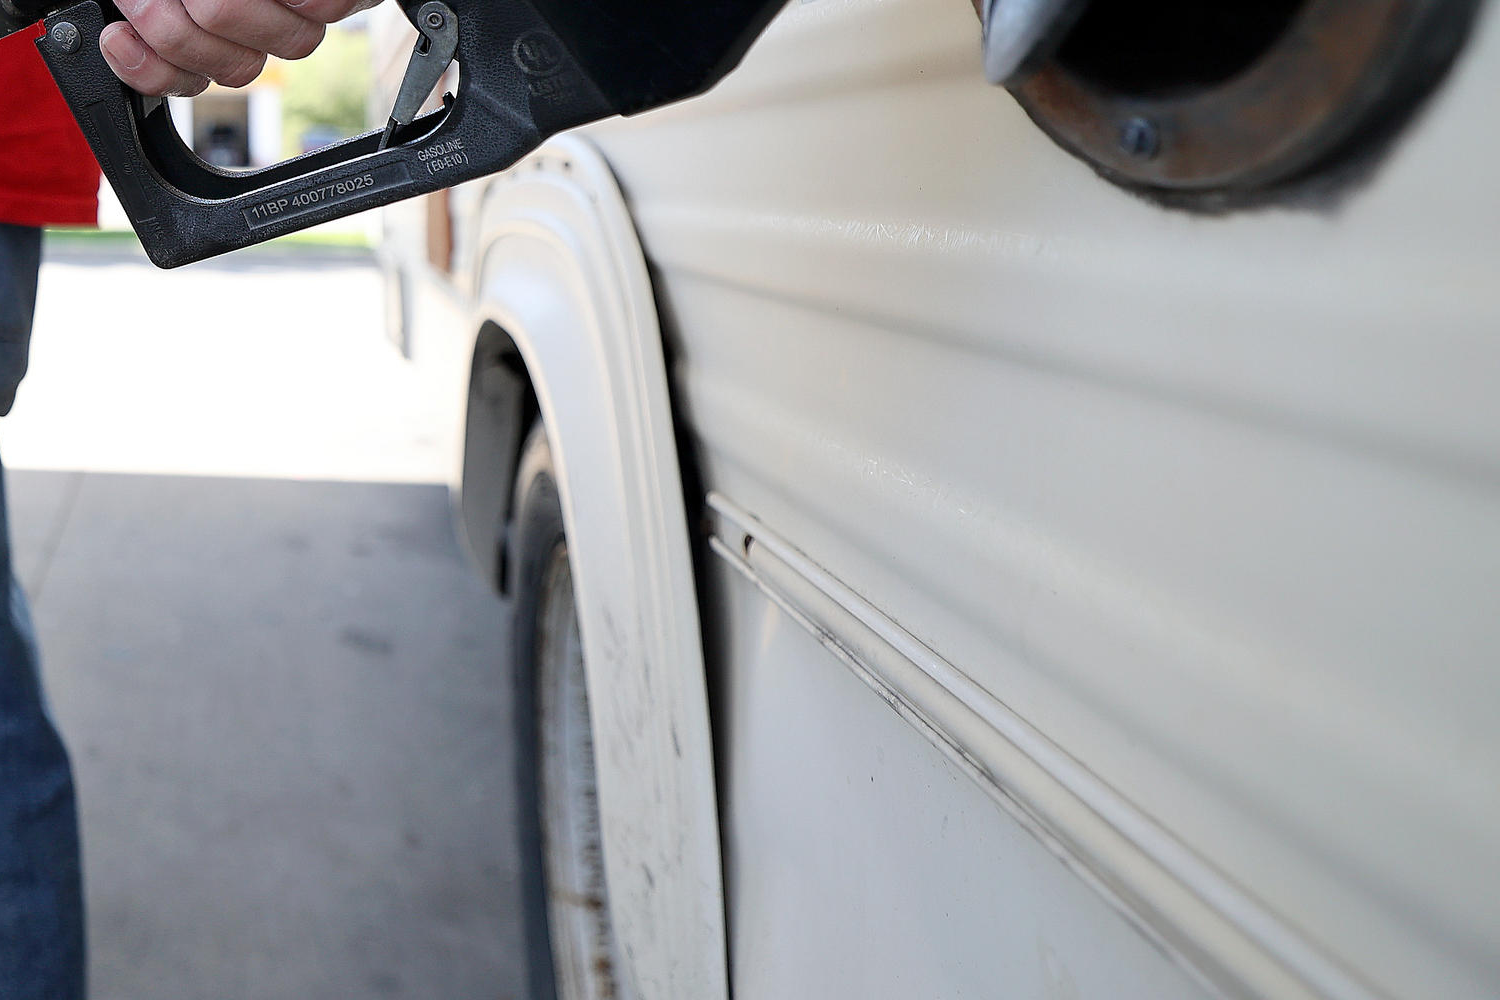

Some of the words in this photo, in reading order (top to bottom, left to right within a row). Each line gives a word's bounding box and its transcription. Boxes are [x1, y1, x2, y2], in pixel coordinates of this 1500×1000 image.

[417, 138, 464, 162] GASOLINE
[252, 199, 288, 219] 11BP
[291, 174, 374, 207] 400778025
